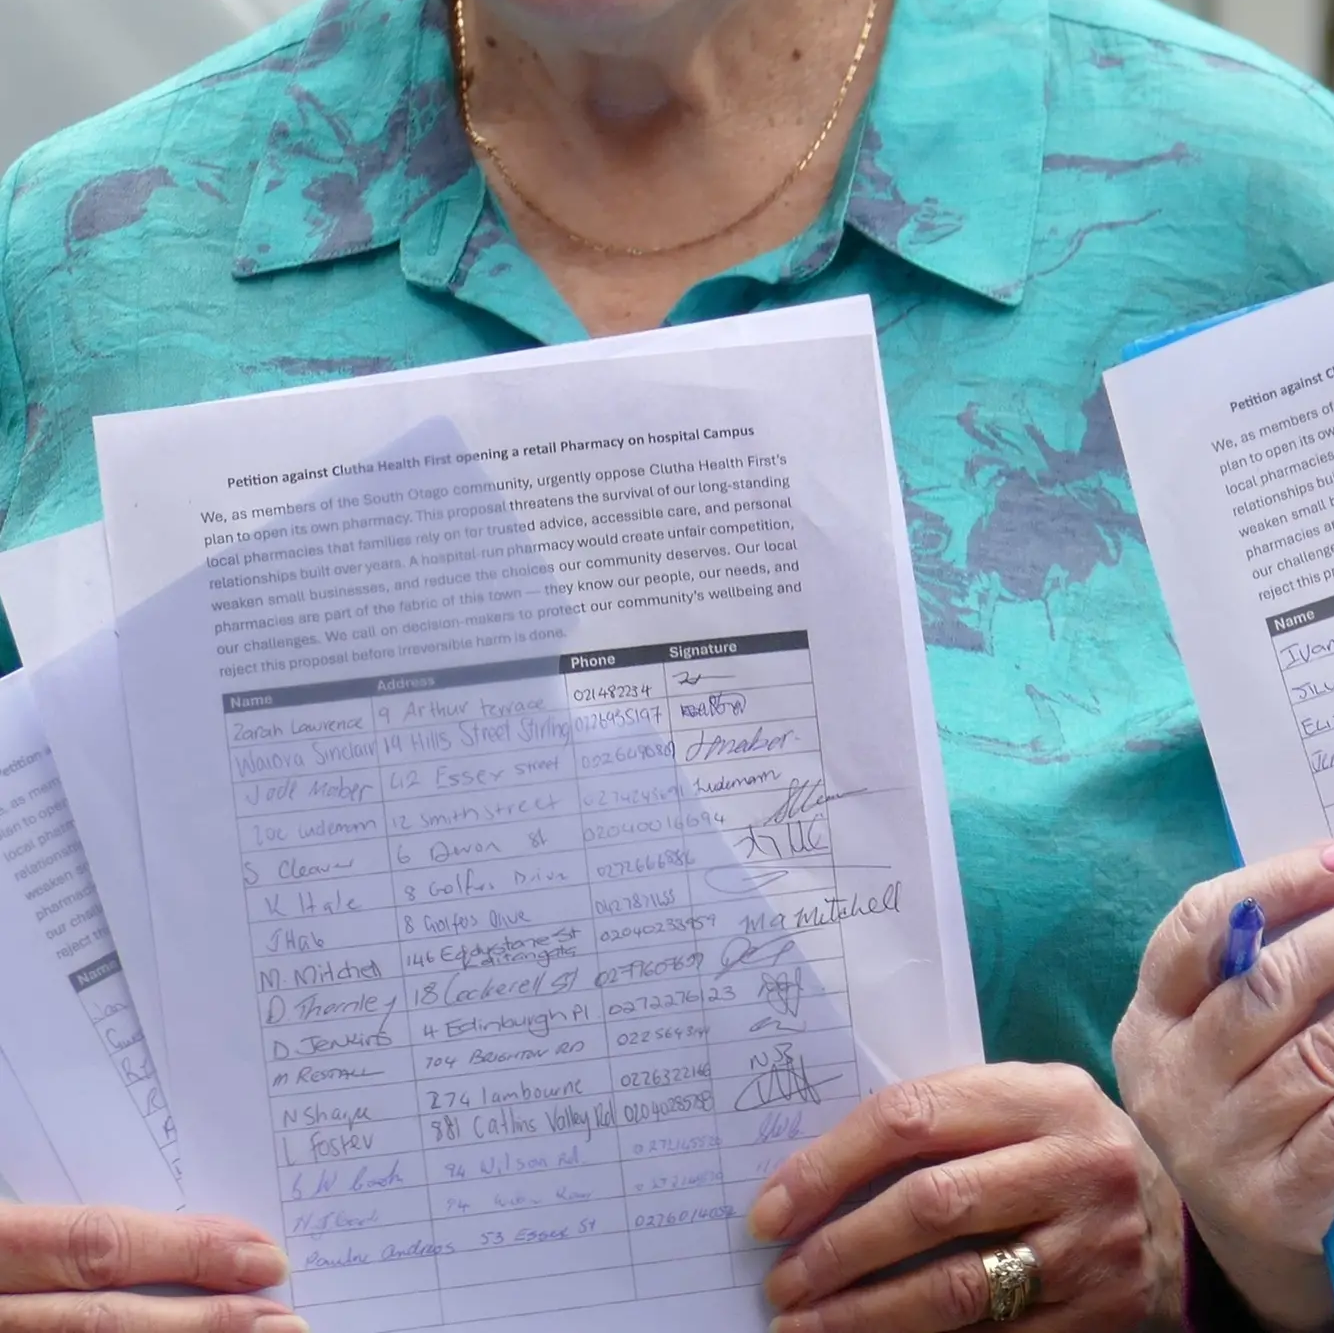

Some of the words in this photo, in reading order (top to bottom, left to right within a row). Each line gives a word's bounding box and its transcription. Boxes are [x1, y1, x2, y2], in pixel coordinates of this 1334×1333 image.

[1229, 389, 1279, 414] Petition
[1279, 371, 1324, 397] against
[1210, 438, 1239, 454] We,
[1239, 430, 1257, 444] as
[1258, 408, 1320, 438] members
[1320, 400, 1334, 416] of
[226, 473, 279, 489] Petition
[281, 467, 329, 485] against
[331, 462, 375, 477] Clutha
[376, 456, 421, 473] Health
[423, 453, 452, 467] First
[455, 447, 510, 465] opening
[511, 447, 520, 458] a
[522, 440, 557, 457] retail
[559, 437, 625, 453] Pharmacy
[627, 435, 646, 447] on
[647, 427, 701, 446] hospital
[702, 427, 755, 440] Campus
[199, 510, 228, 525] We,
[231, 509, 248, 521] as
[251, 501, 317, 519] members
[319, 496, 334, 512] of
[336, 496, 360, 509] the
[362, 490, 405, 507] South
[406, 486, 450, 502] Otago
[452, 476, 534, 497] community,
[536, 470, 592, 489] urgently
[594, 466, 646, 483] oppose
[648, 461, 695, 476] Clutha
[697, 456, 744, 472] Health
[746, 453, 788, 468] First's
[215, 642, 240, 656] our
[242, 634, 322, 653] challenges.
[323, 629, 349, 643] We
[351, 624, 377, 641] call
[379, 624, 399, 637] on
[401, 611, 516, 635] decision-makers
[517, 609, 534, 621] to
[536, 602, 587, 621] protect
[589, 600, 613, 613] our
[616, 589, 705, 610] community's
[707, 583, 775, 601] wellbeing
[776, 580, 803, 595] and
[1274, 610, 1314, 631] Name
[572, 653, 615, 668] Phone
[670, 641, 736, 658] Signature
[378, 676, 434, 691] Address
[231, 695, 272, 709] Name
